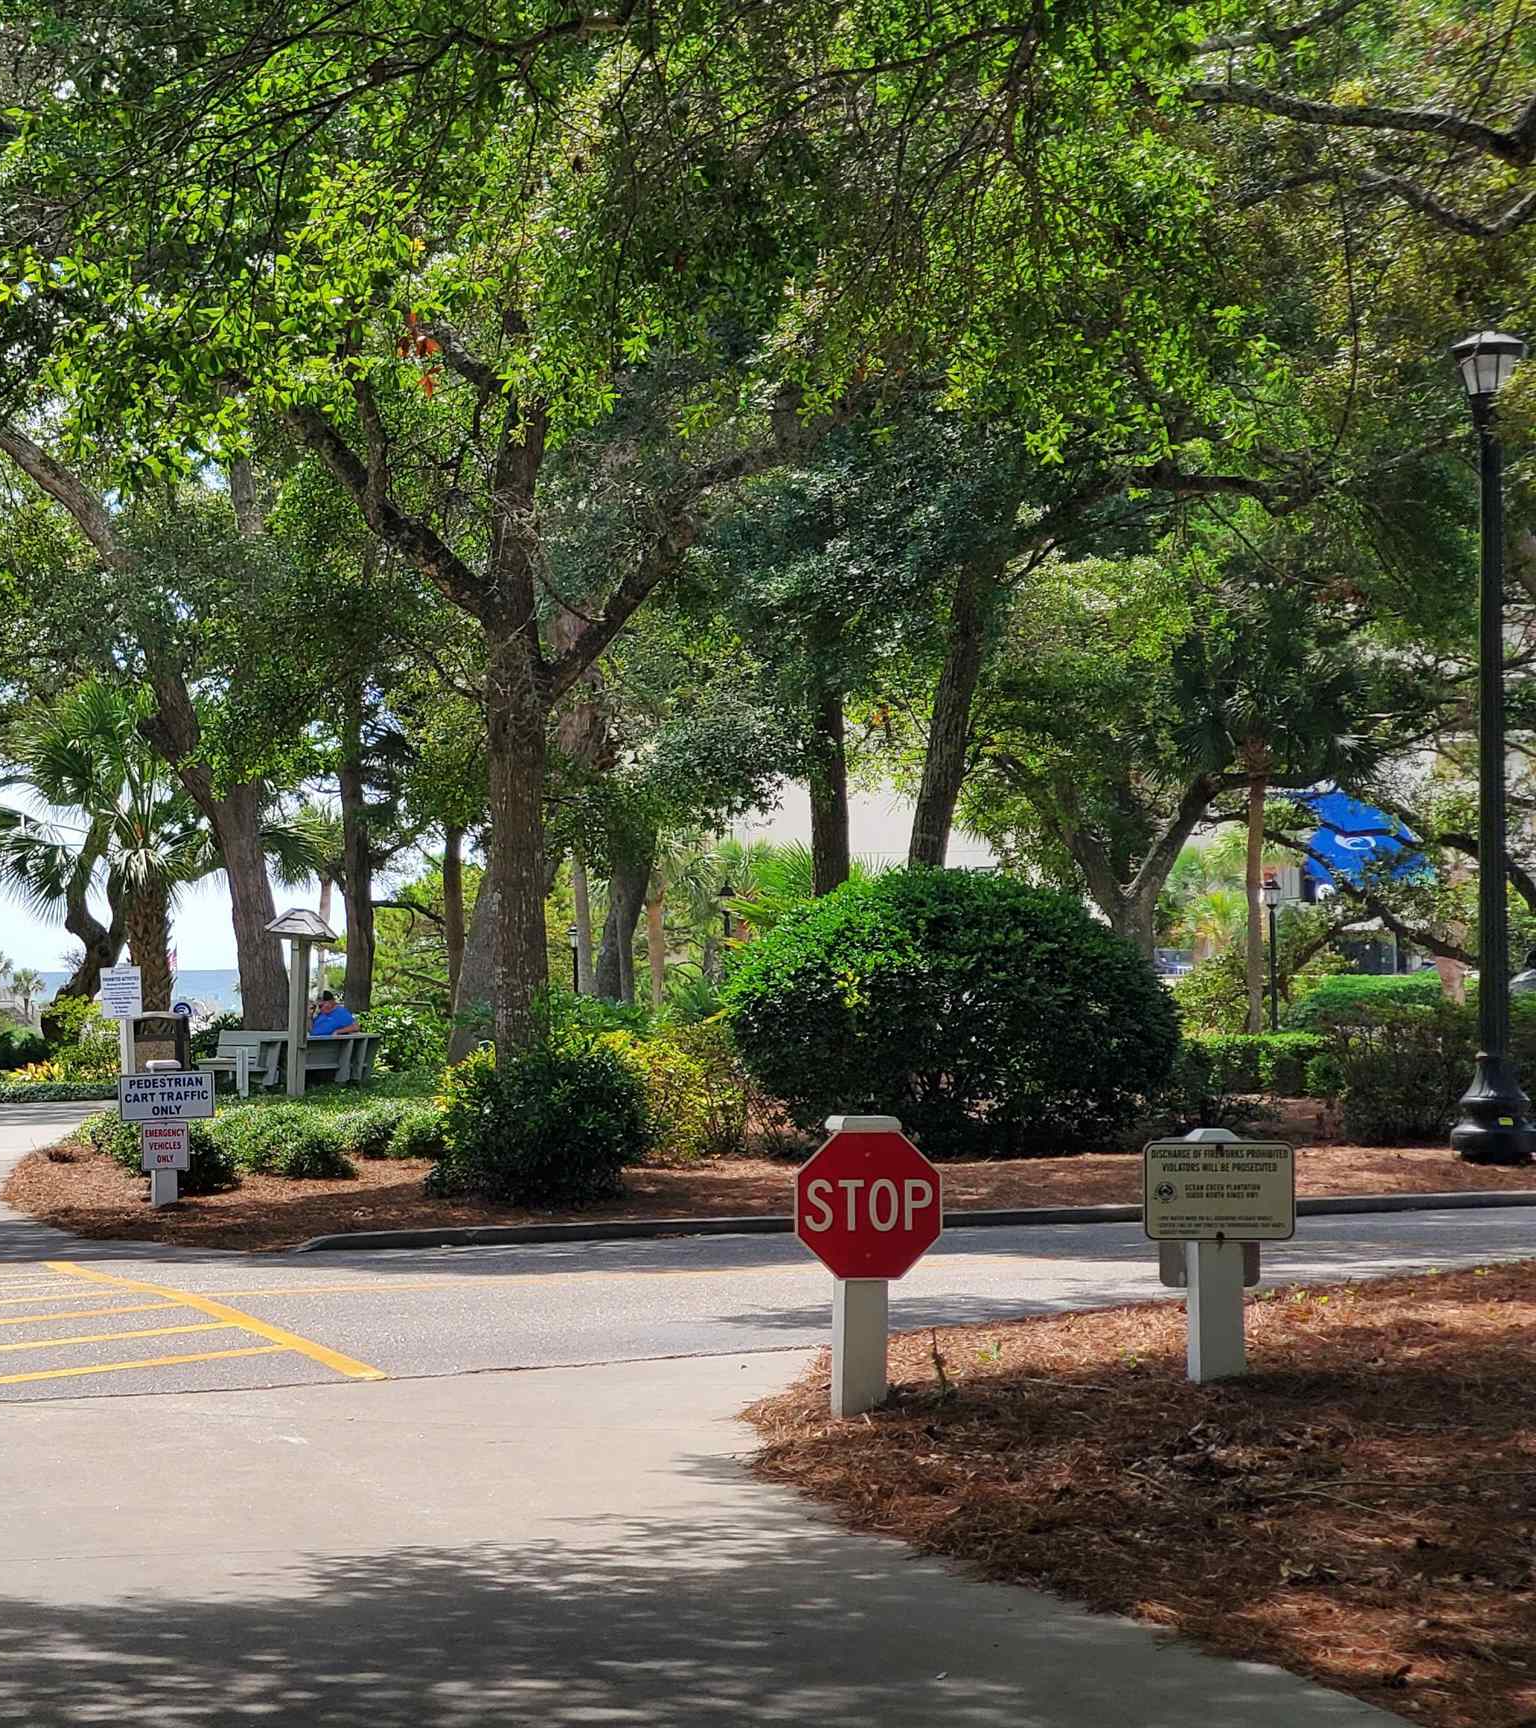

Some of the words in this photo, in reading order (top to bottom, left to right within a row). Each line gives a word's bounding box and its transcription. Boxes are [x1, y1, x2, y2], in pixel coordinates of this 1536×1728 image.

[129, 1076, 203, 1090] PEDESTRIAN
[124, 1092, 156, 1103] CART
[159, 1090, 209, 1102] TRAFFIC
[152, 1105, 182, 1116] ONLY
[145, 1128, 185, 1138] EMERGENCY
[148, 1141, 182, 1151] VEHICLES
[156, 1154, 174, 1164] ONLY
[1151, 1149, 1191, 1159] DISCHARGE
[1193, 1149, 1201, 1159] OF
[1246, 1149, 1289, 1159] PROHIBITED
[1161, 1162, 1200, 1172] VIOLATORS
[1202, 1162, 1218, 1172] WILL
[1221, 1162, 1230, 1172] BE
[1232, 1162, 1277, 1172] PROSECUTED
[804, 1178, 934, 1233] STOP
